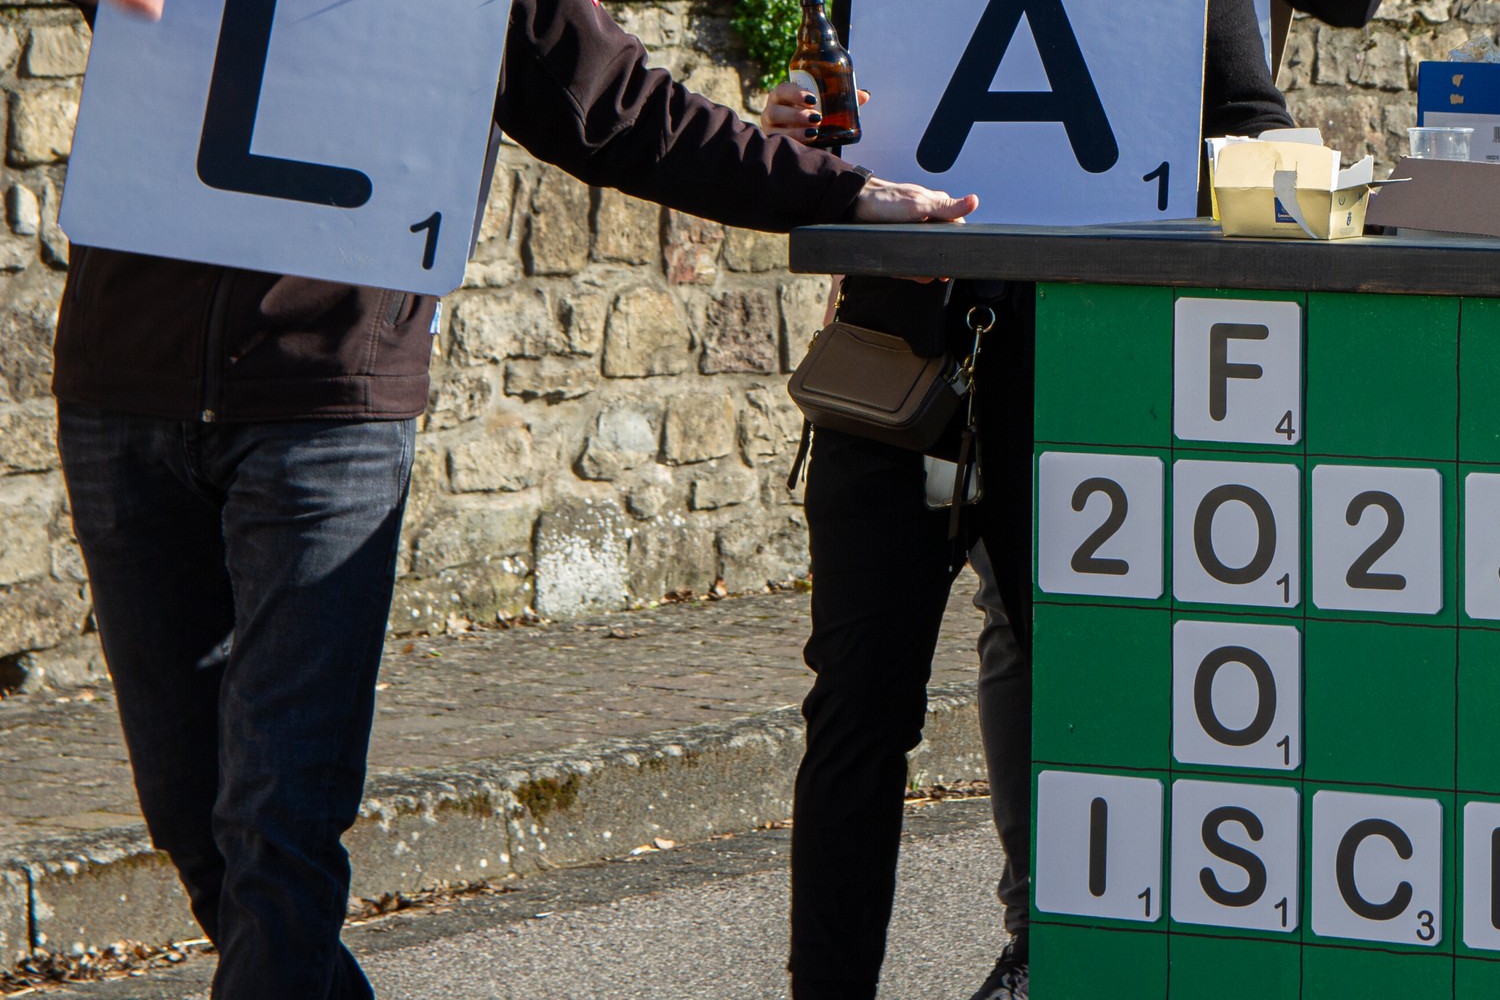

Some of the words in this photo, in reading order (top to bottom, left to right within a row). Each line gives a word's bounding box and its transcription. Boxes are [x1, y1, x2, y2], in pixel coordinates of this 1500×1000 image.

[1143, 162, 1169, 211] 1
[410, 212, 441, 270] 1
[1275, 410, 1295, 440] 4
[1277, 573, 1289, 603] 1
[1277, 735, 1289, 765] 1
[1138, 887, 1150, 917] 1
[1274, 897, 1287, 927] 1
[1417, 910, 1435, 941] 3
